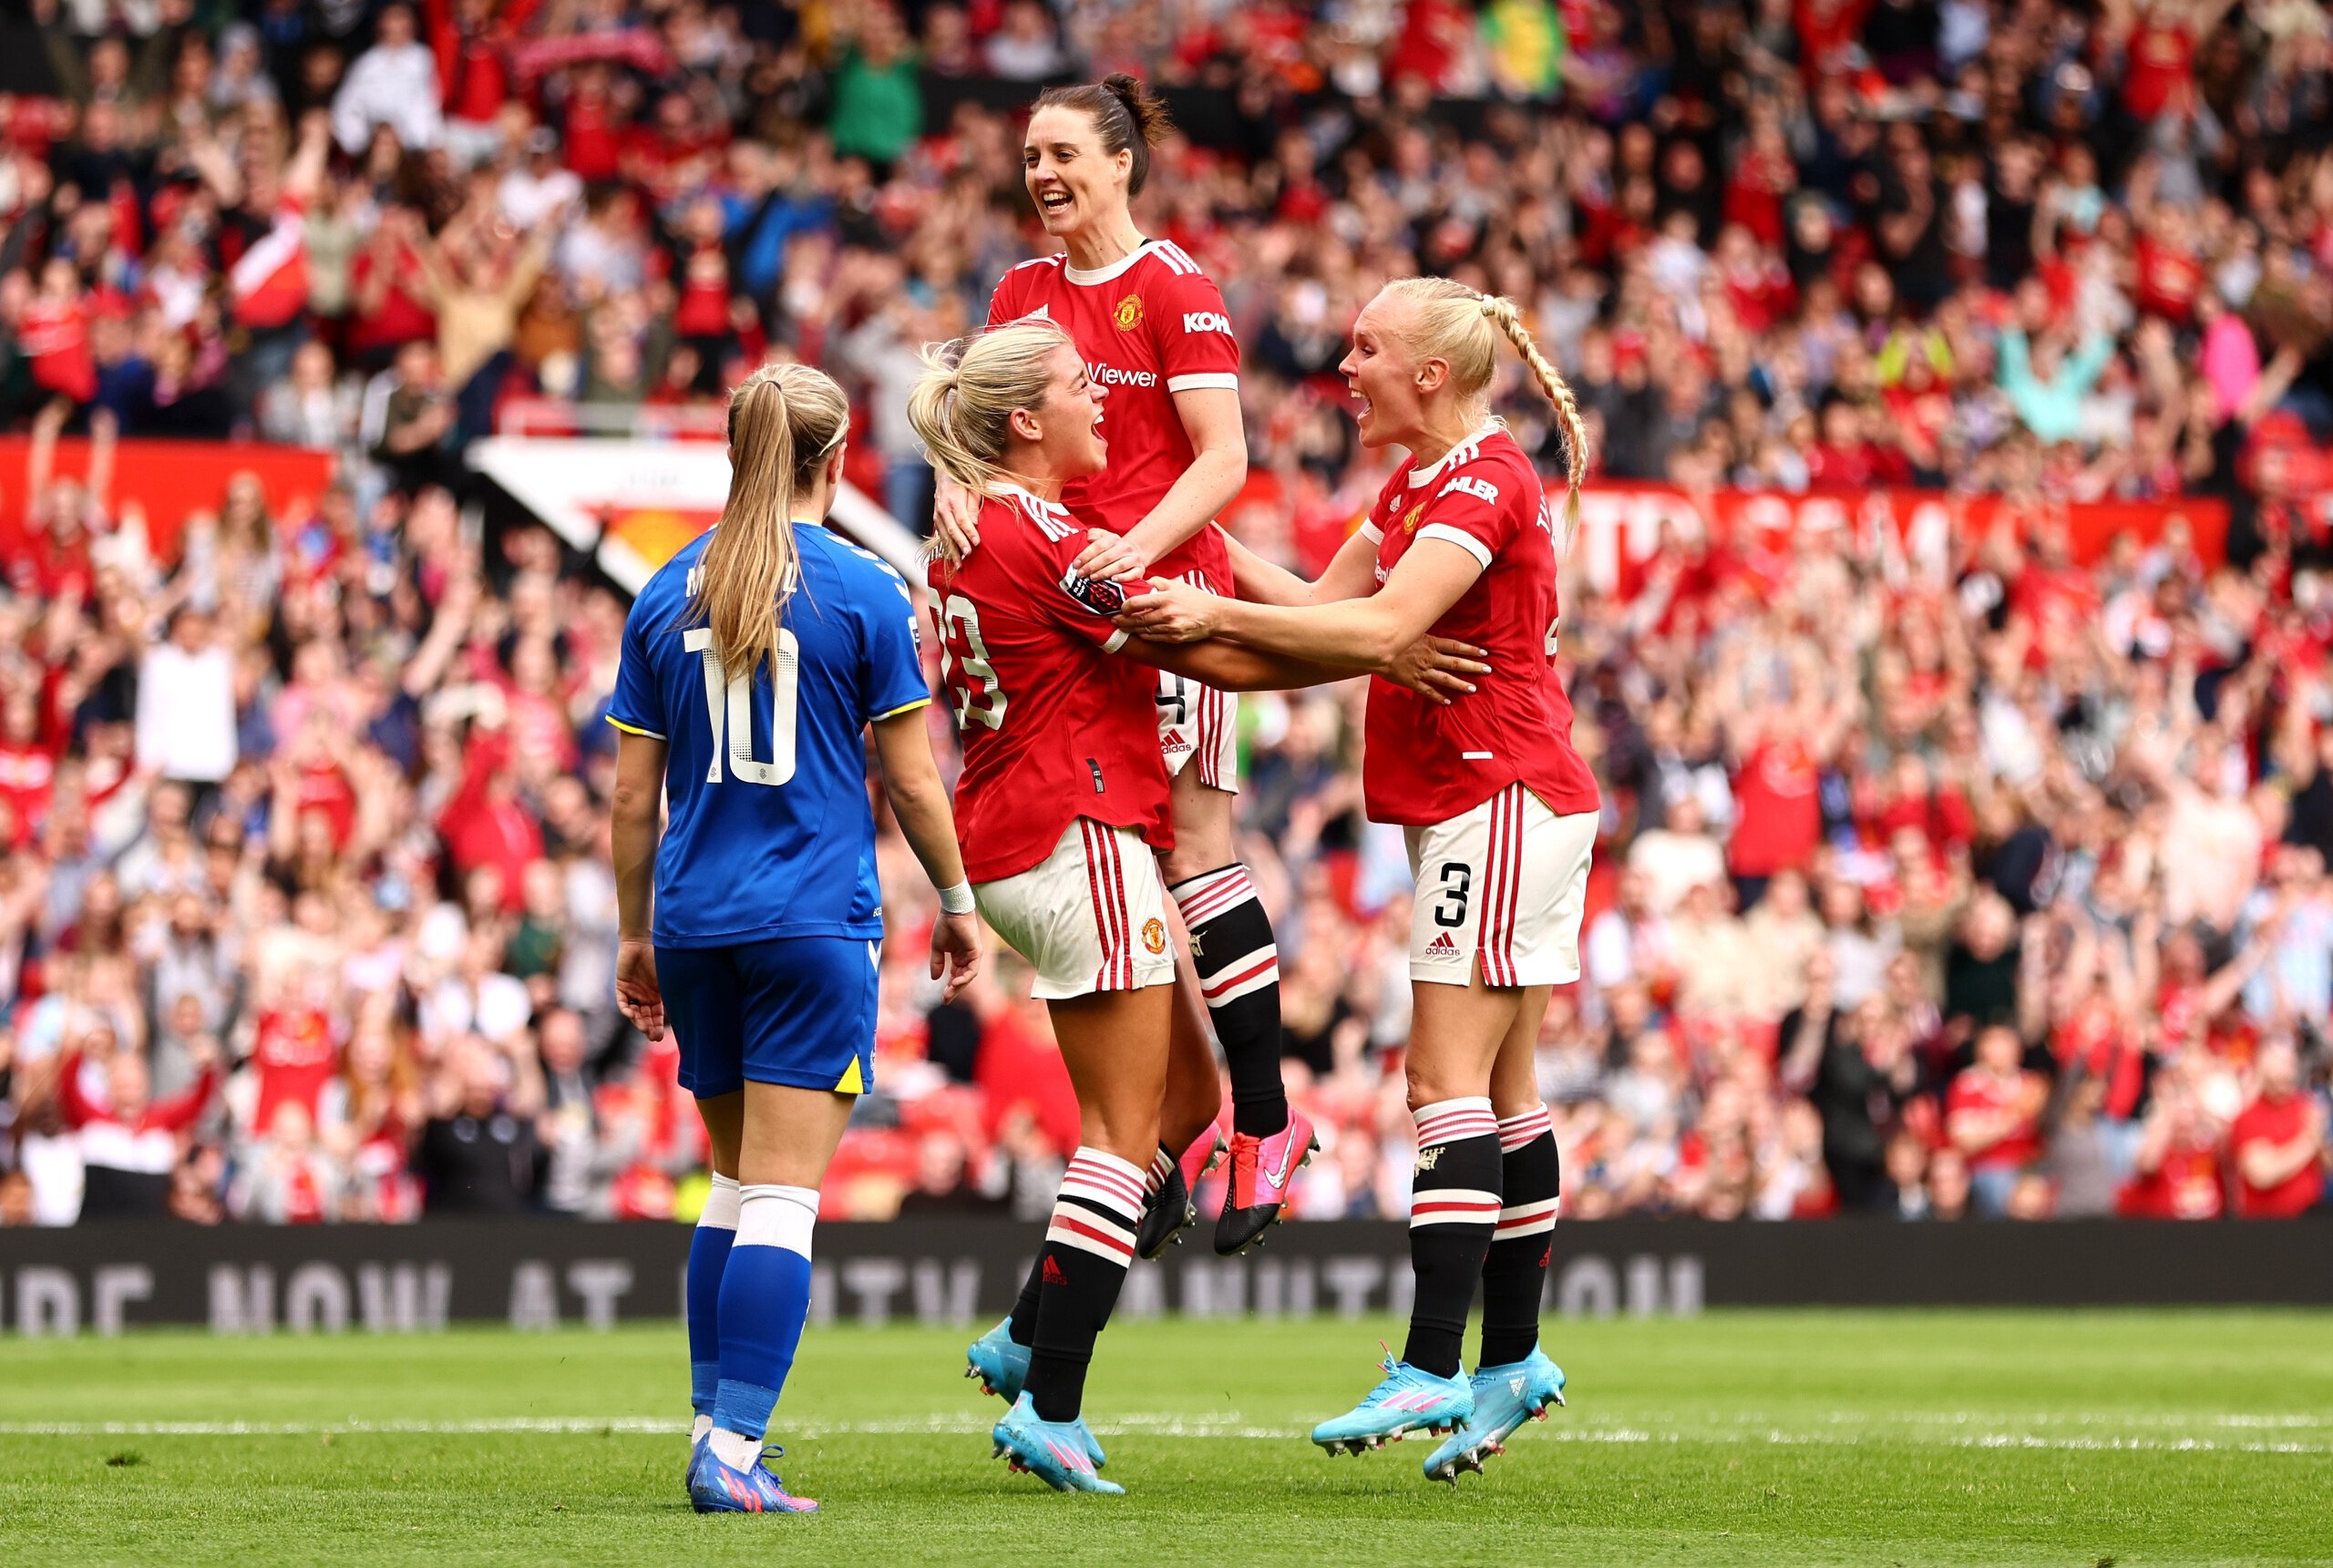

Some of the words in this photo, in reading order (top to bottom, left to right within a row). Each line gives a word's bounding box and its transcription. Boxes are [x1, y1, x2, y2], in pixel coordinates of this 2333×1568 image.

[1182, 311, 1234, 337] KOH
[1087, 361, 1157, 388] Viewer
[1436, 475, 1500, 507] HLER
[683, 627, 799, 786] 10
[1161, 743, 1192, 755] didas
[1434, 861, 1472, 928] 3
[1425, 945, 1461, 957] adidas
[208, 1260, 453, 1334] NOW
[510, 1256, 635, 1334] AT
